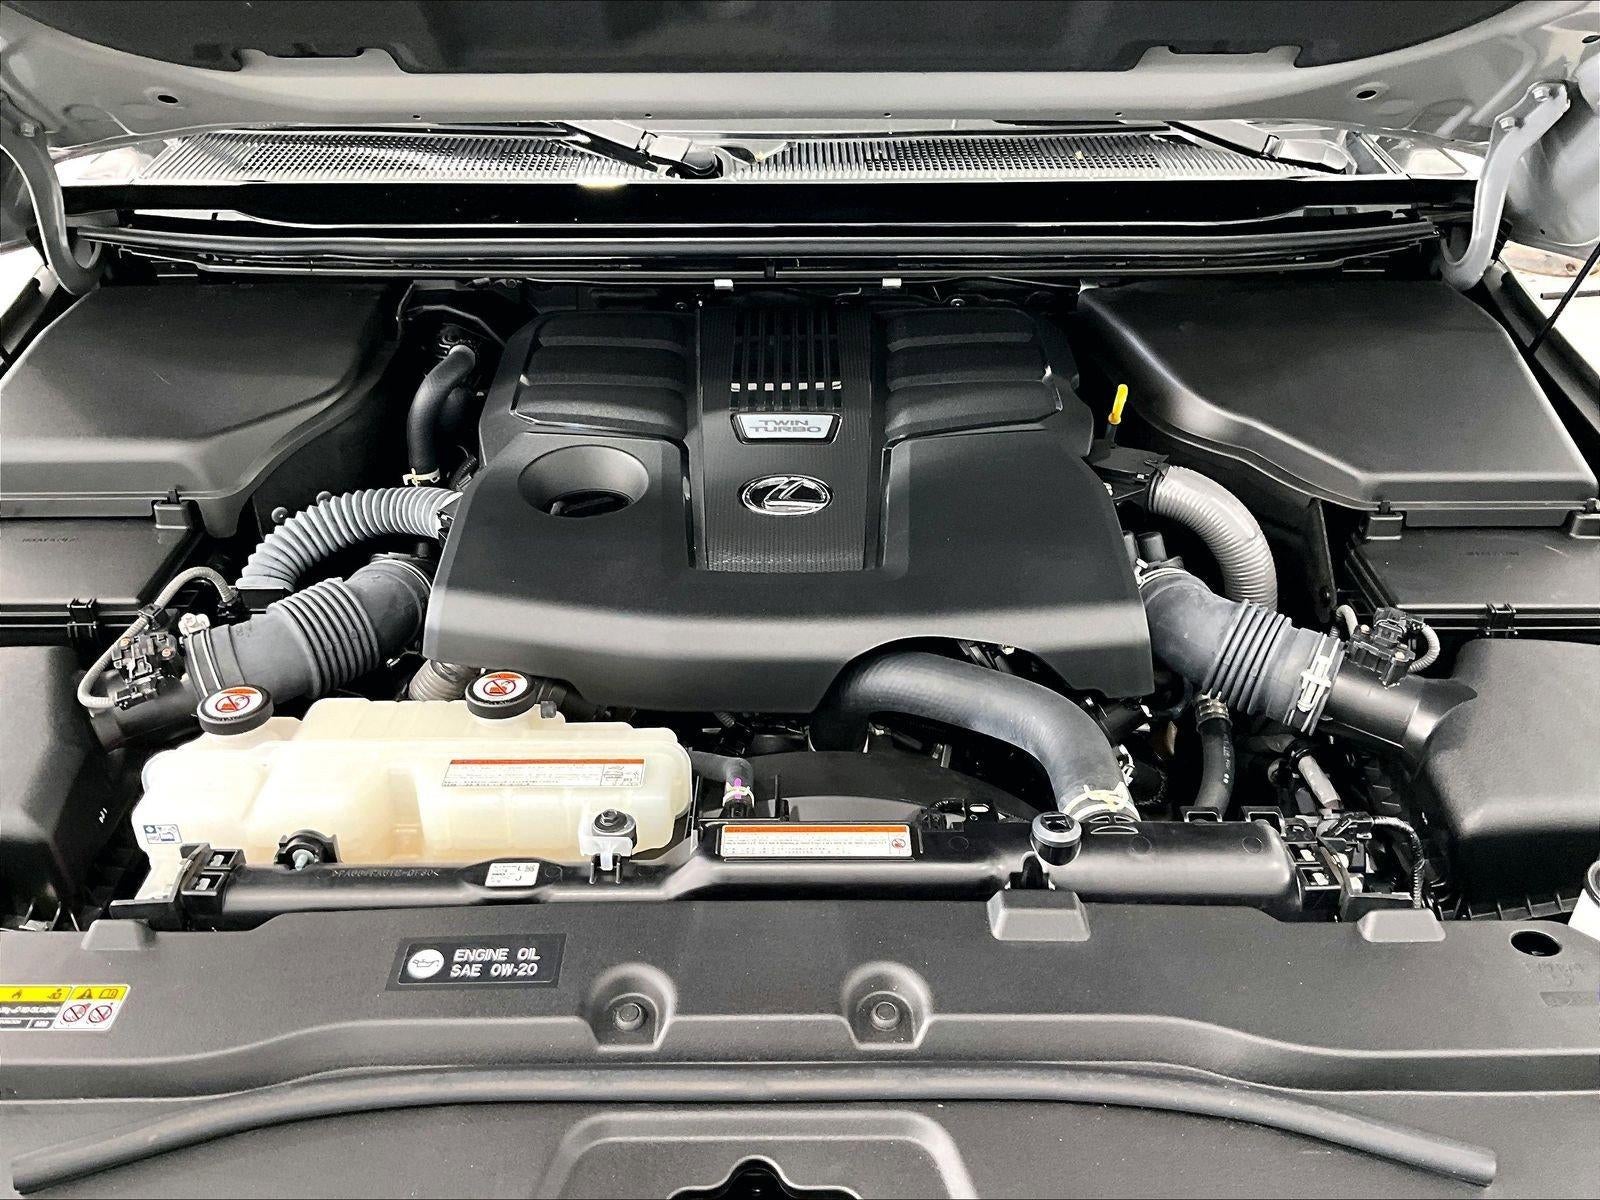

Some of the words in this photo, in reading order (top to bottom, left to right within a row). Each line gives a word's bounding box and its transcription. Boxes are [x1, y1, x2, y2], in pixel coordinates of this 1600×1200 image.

[453, 948, 510, 962] ENGINE
[516, 947, 541, 961] OIL
[449, 963, 483, 978] SAE
[489, 962, 539, 977] 0W-20
